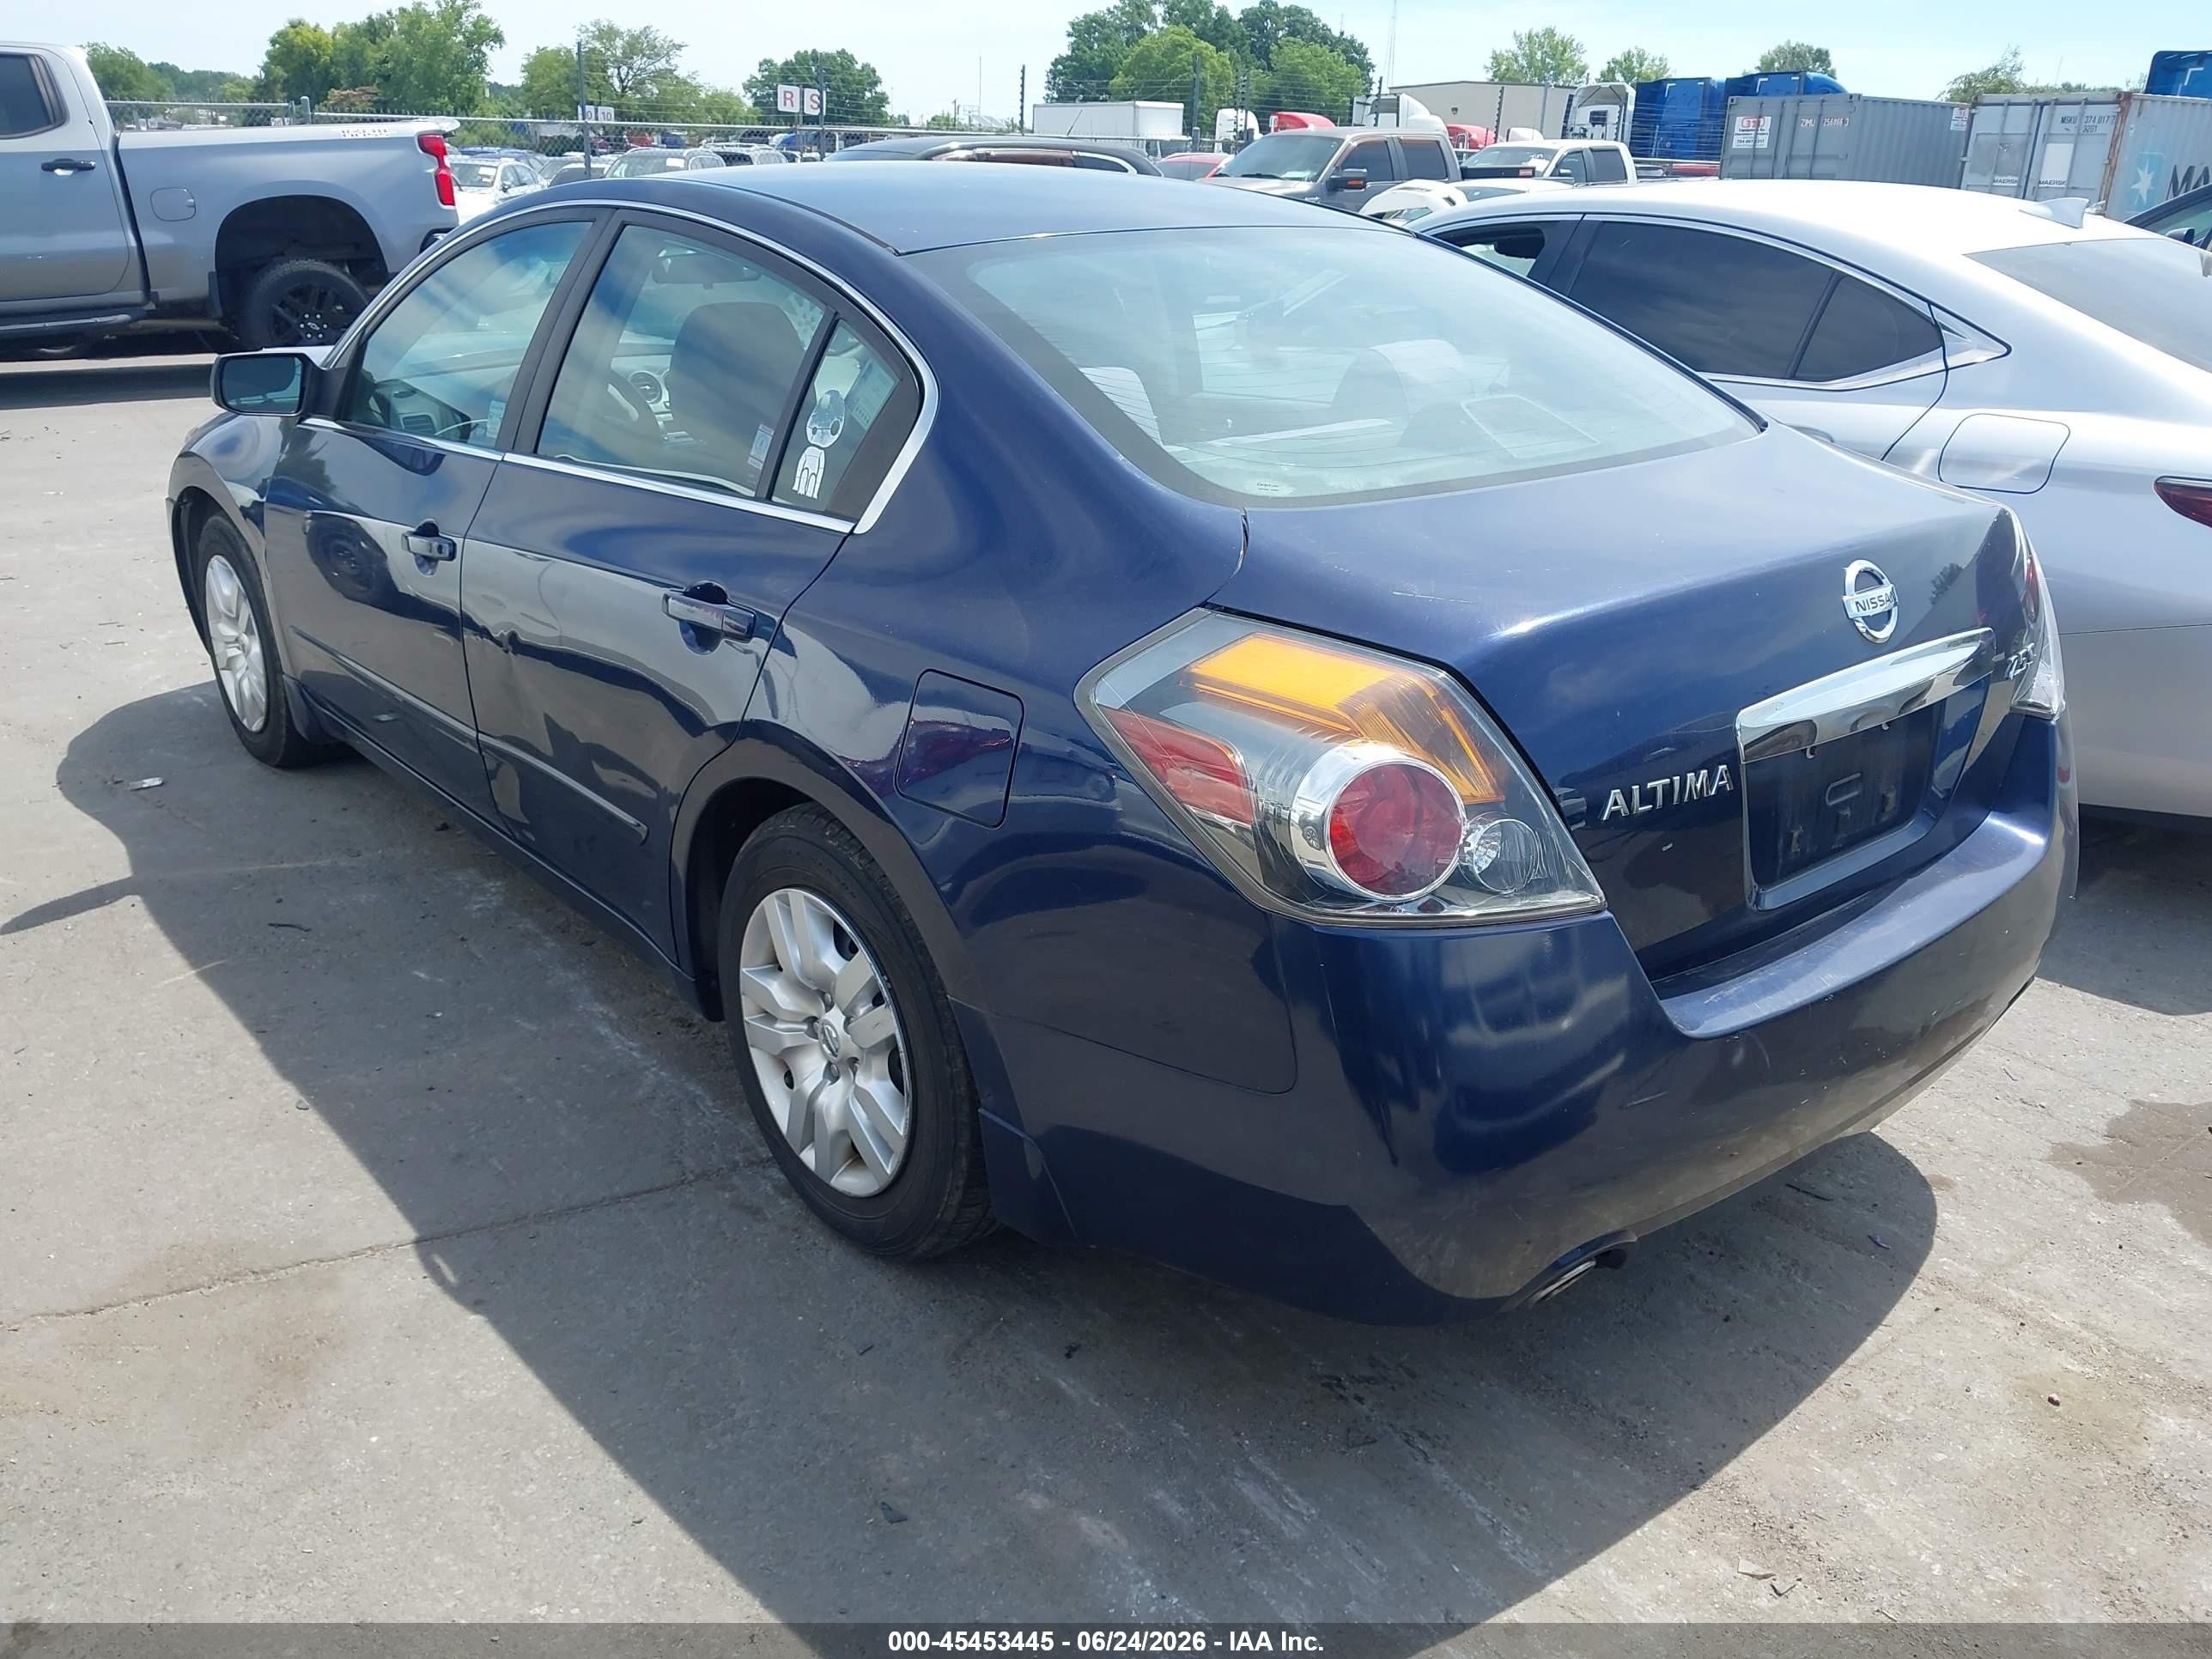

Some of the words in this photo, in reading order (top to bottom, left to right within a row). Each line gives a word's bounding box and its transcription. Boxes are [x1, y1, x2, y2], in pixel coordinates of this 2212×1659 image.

[783, 90, 794, 107] R
[810, 93, 821, 110] S
[1855, 586, 1897, 612] NISSAN
[1601, 764, 1734, 821] ALTIMA
